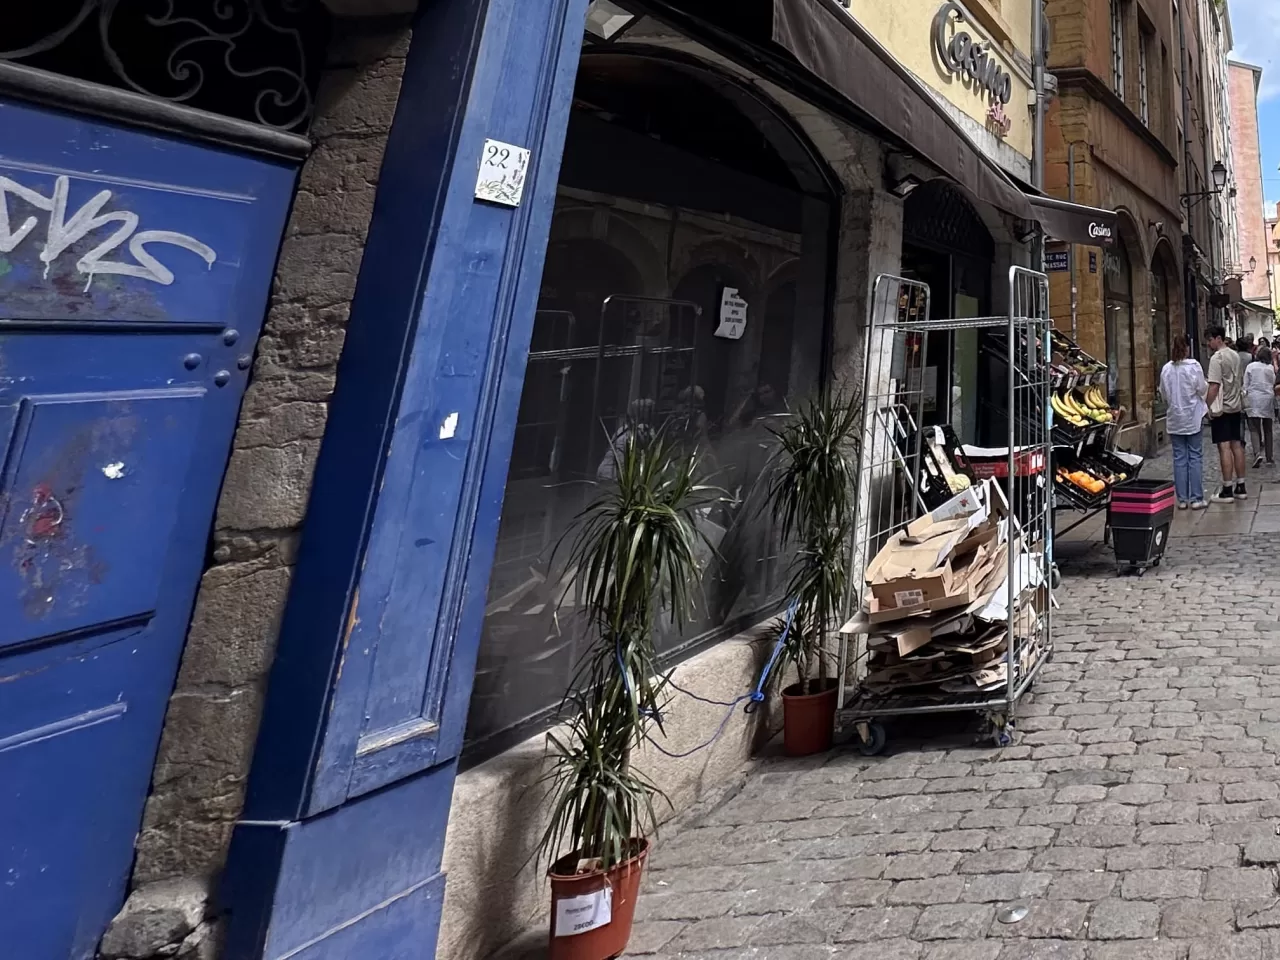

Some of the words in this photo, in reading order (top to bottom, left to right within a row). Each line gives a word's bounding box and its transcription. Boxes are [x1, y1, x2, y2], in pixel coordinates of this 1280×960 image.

[935, 1, 1012, 105] Casino
[484, 145, 511, 169] 22
[1088, 222, 1111, 238] Casino
